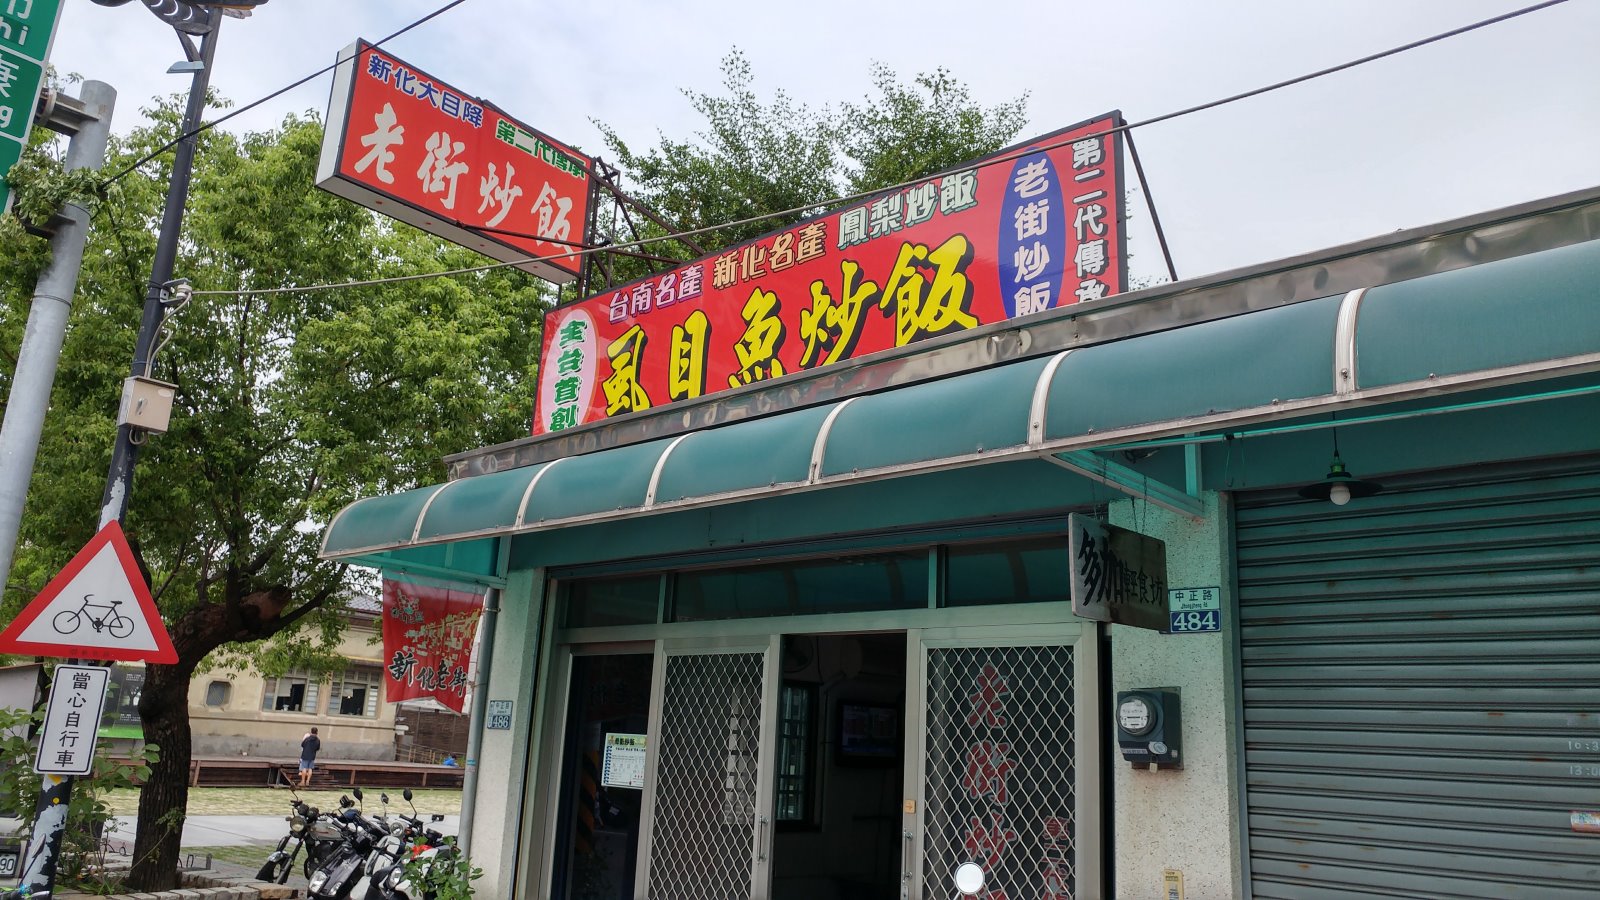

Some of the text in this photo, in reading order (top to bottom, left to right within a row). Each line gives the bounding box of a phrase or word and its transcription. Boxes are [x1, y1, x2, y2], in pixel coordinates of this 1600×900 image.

[368, 54, 484, 128] 新化大目降
[354, 102, 575, 262] 老街炒飯
[837, 169, 978, 250] 鳳梨炒飯
[1072, 134, 1107, 304] 第二代傳承
[712, 221, 826, 289] 新化名產
[1013, 157, 1051, 318] 老街炒飯
[602, 234, 979, 417] 虱目魚炒飯
[608, 264, 704, 324] 台南名產
[1173, 611, 1216, 631] 484
[1175, 589, 1213, 602] 中正路
[388, 650, 468, 697] 新化老街
[55, 672, 91, 767] 當心自行車
[492, 715, 509, 728] 486
